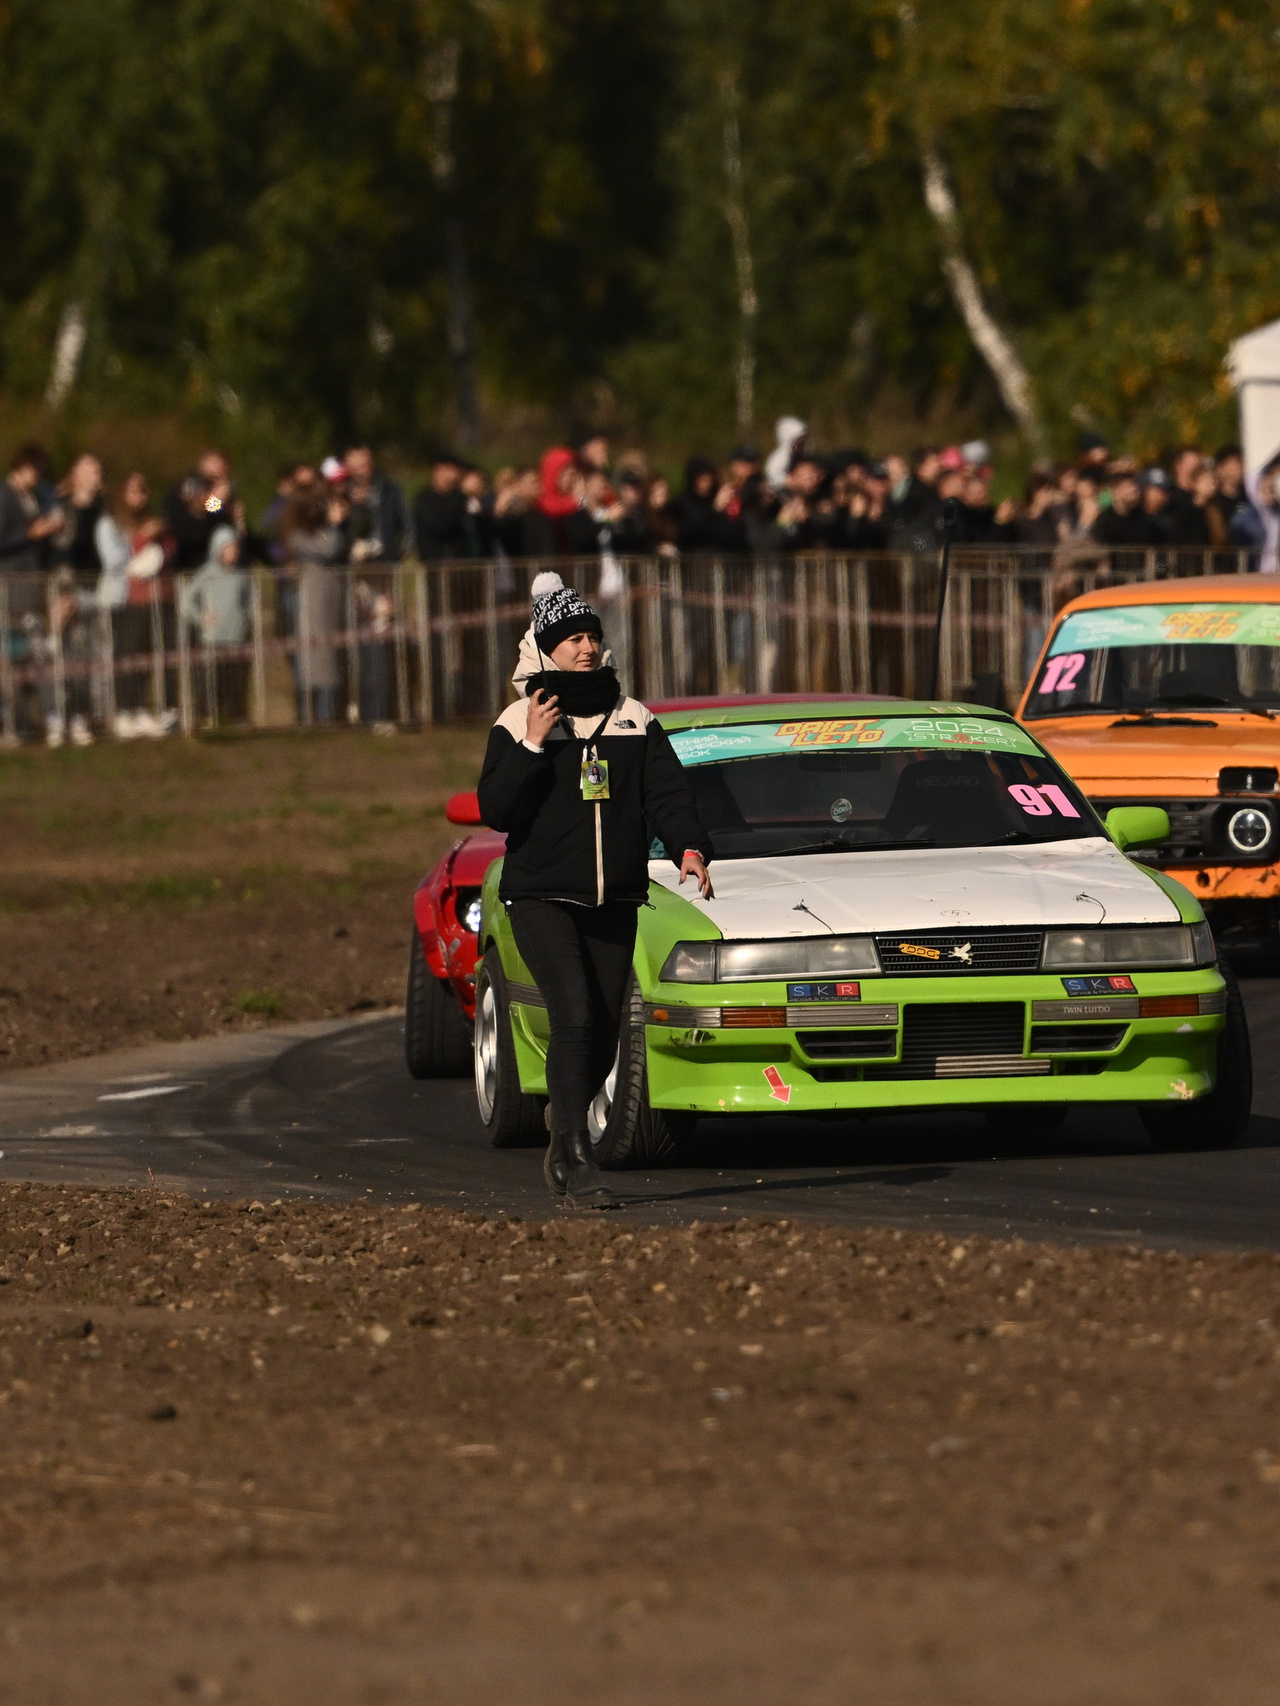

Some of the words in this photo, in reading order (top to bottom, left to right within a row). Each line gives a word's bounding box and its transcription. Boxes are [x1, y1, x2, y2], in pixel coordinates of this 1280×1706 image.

[1039, 653, 1087, 694] 12
[775, 718, 880, 736] DRIFT
[911, 720, 1004, 737] 2024
[790, 730, 884, 746] LETO
[915, 776, 980, 787] RECARO
[1007, 784, 1081, 818] 91
[793, 985, 854, 996] SKR
[1068, 978, 1129, 990] SKR
[1063, 1006, 1083, 1014] TWIN
